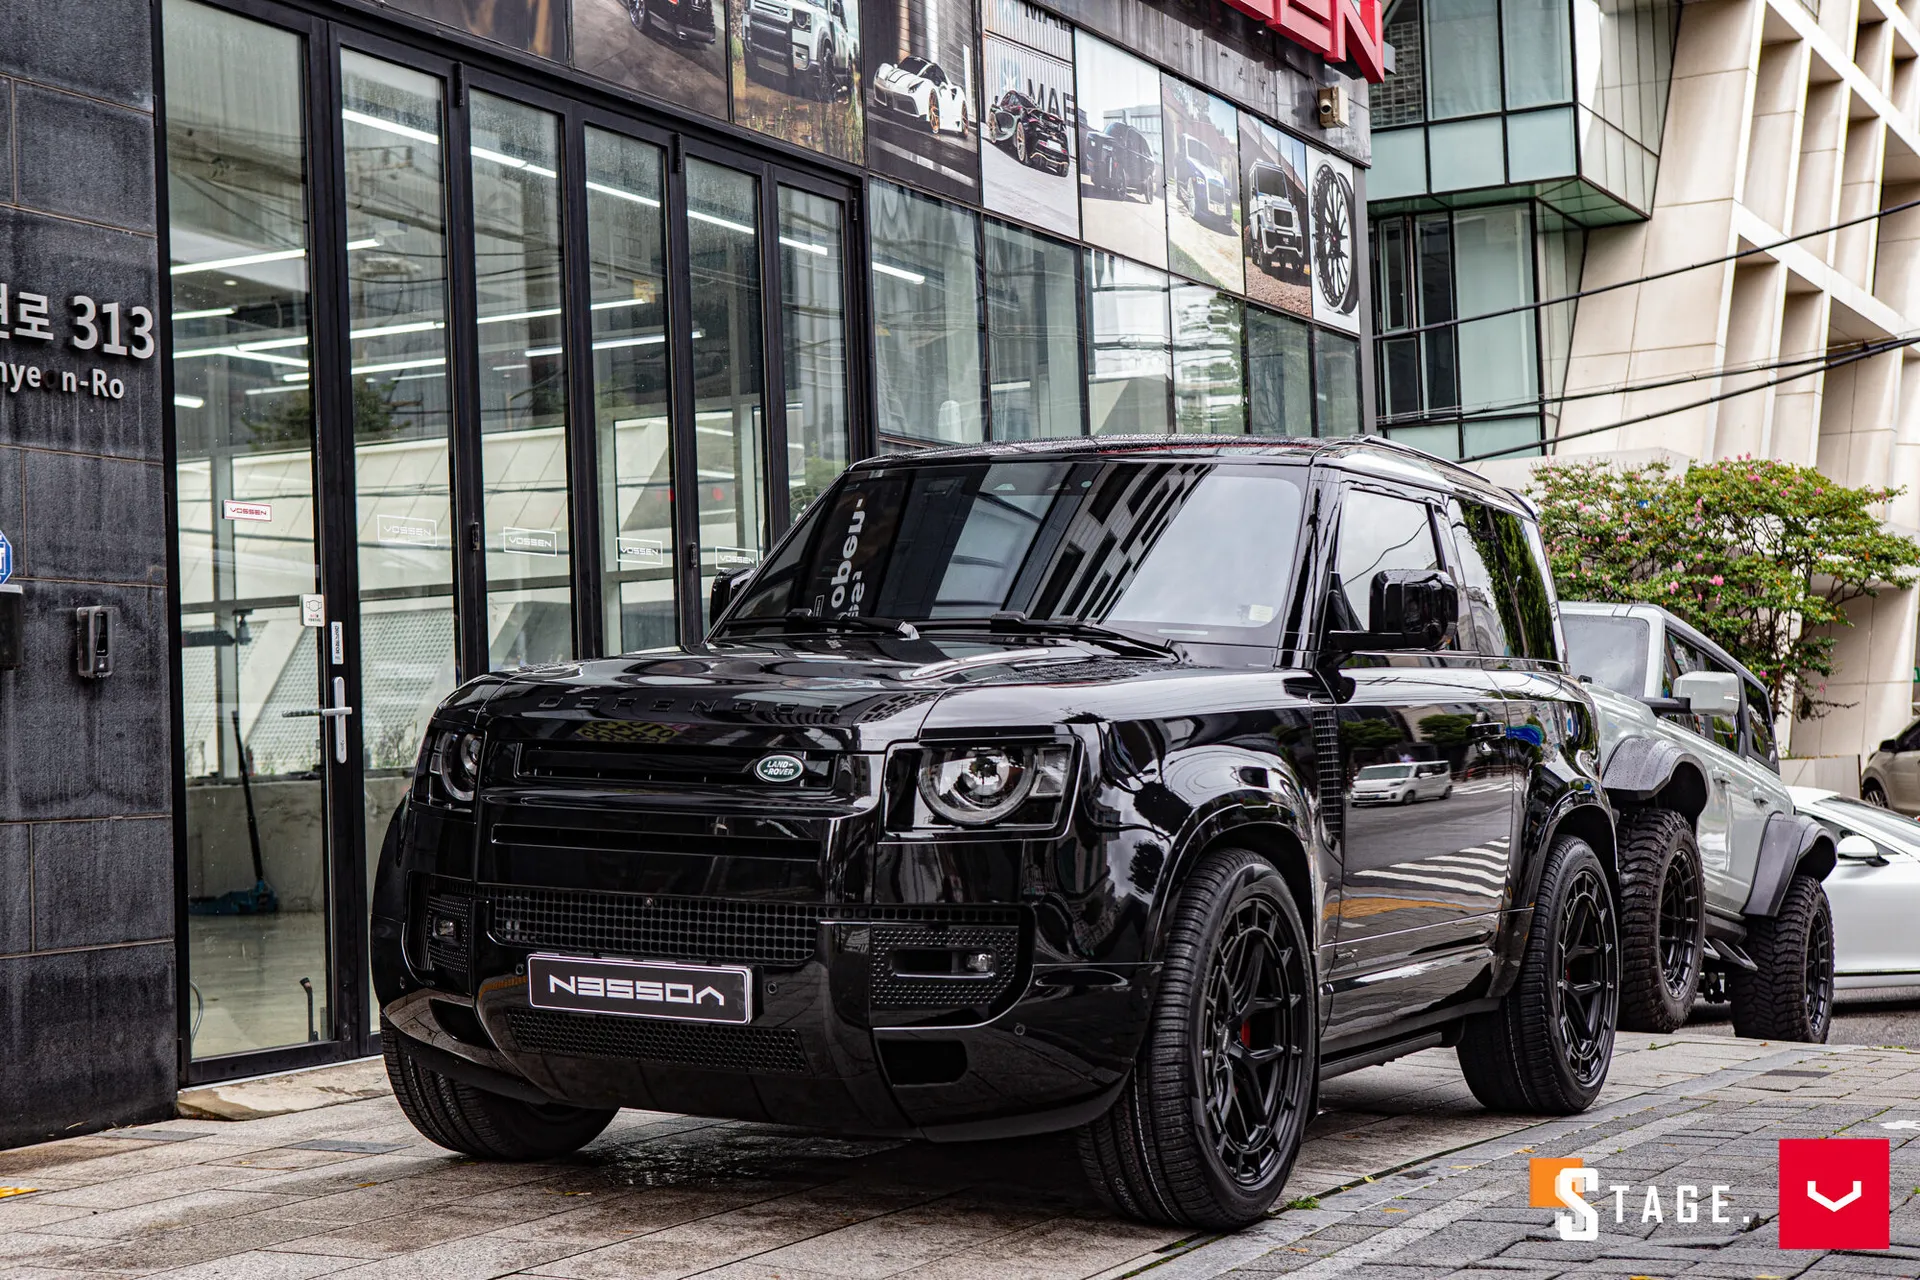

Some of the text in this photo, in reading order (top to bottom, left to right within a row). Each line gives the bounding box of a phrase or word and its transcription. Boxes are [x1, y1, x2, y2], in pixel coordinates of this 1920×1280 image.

[0, 283, 155, 360] 로 313
[229, 507, 267, 516] VOSSEN
[382, 524, 432, 537] VOSSEN
[508, 536, 552, 548] VOSSEN
[620, 547, 659, 556] VOSSEN
[719, 554, 755, 564] VOSSEN
[538, 697, 841, 716] DEFENDER
